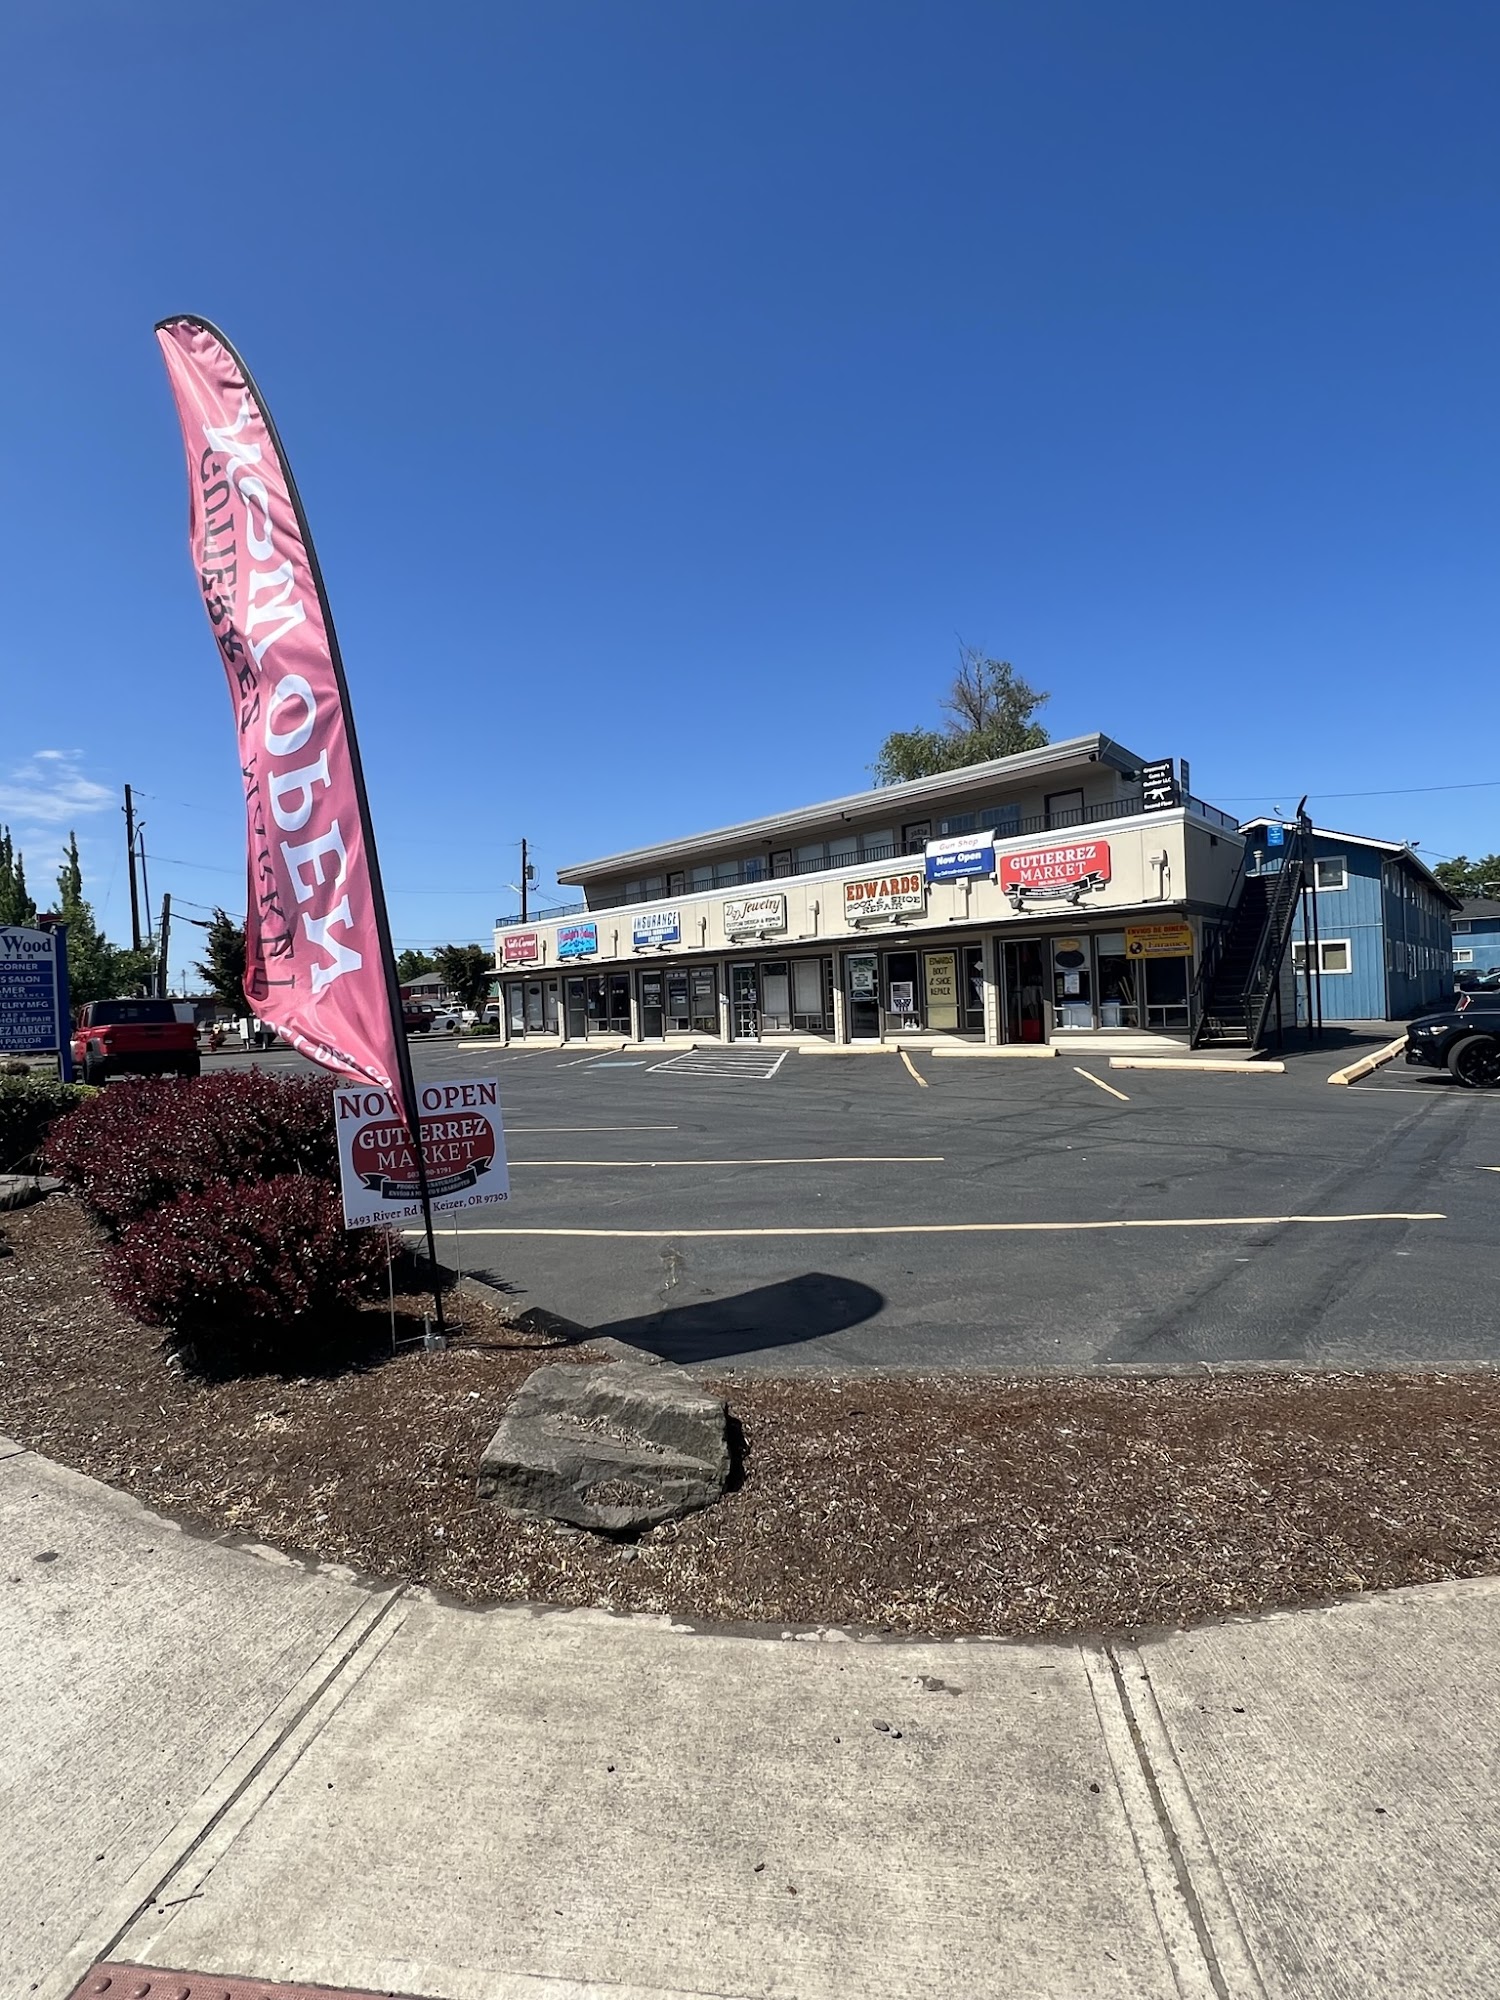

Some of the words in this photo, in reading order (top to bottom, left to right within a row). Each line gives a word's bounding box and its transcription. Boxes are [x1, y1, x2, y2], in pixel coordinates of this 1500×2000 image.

[958, 839, 978, 848] Shop
[936, 855, 956, 866] Now
[957, 852, 981, 863] Open
[1010, 845, 1096, 870] GUTIERREZ
[1020, 861, 1086, 882] MARKET
[846, 875, 919, 901] EDWARDS
[740, 898, 780, 919] Jewelry
[846, 899, 873, 912] BOOT
[891, 895, 920, 904] SHOE
[862, 902, 903, 914] REPAIR
[633, 911, 677, 930] INSURANCE
[1, 935, 52, 953] Wood
[0, 963, 38, 971] CORNER
[929, 956, 953, 966] EDWARDS
[932, 966, 948, 976] BOOT
[8, 975, 41, 983] SALON
[935, 977, 952, 985] SHOE
[0, 986, 26, 994] MER
[930, 987, 951, 996] REPAIR
[0, 1001, 25, 1009] ELRY
[26, 1000, 49, 1009] MFG
[12, 1024, 53, 1035] MARKET
[5, 1037, 42, 1045] PARLOR
[422, 1083, 497, 1111] OPEN
[358, 1118, 487, 1150] GUTERREZ
[377, 1141, 475, 1171] MARKET
[407, 1166, 452, 1179] 50390-1791
[347, 1215, 371, 1228] 3493
[373, 1209, 402, 1222] River
[404, 1204, 418, 1217] Rd
[433, 1198, 467, 1212] Keizer,
[468, 1195, 482, 1205] OR
[484, 1192, 508, 1203] 97303
